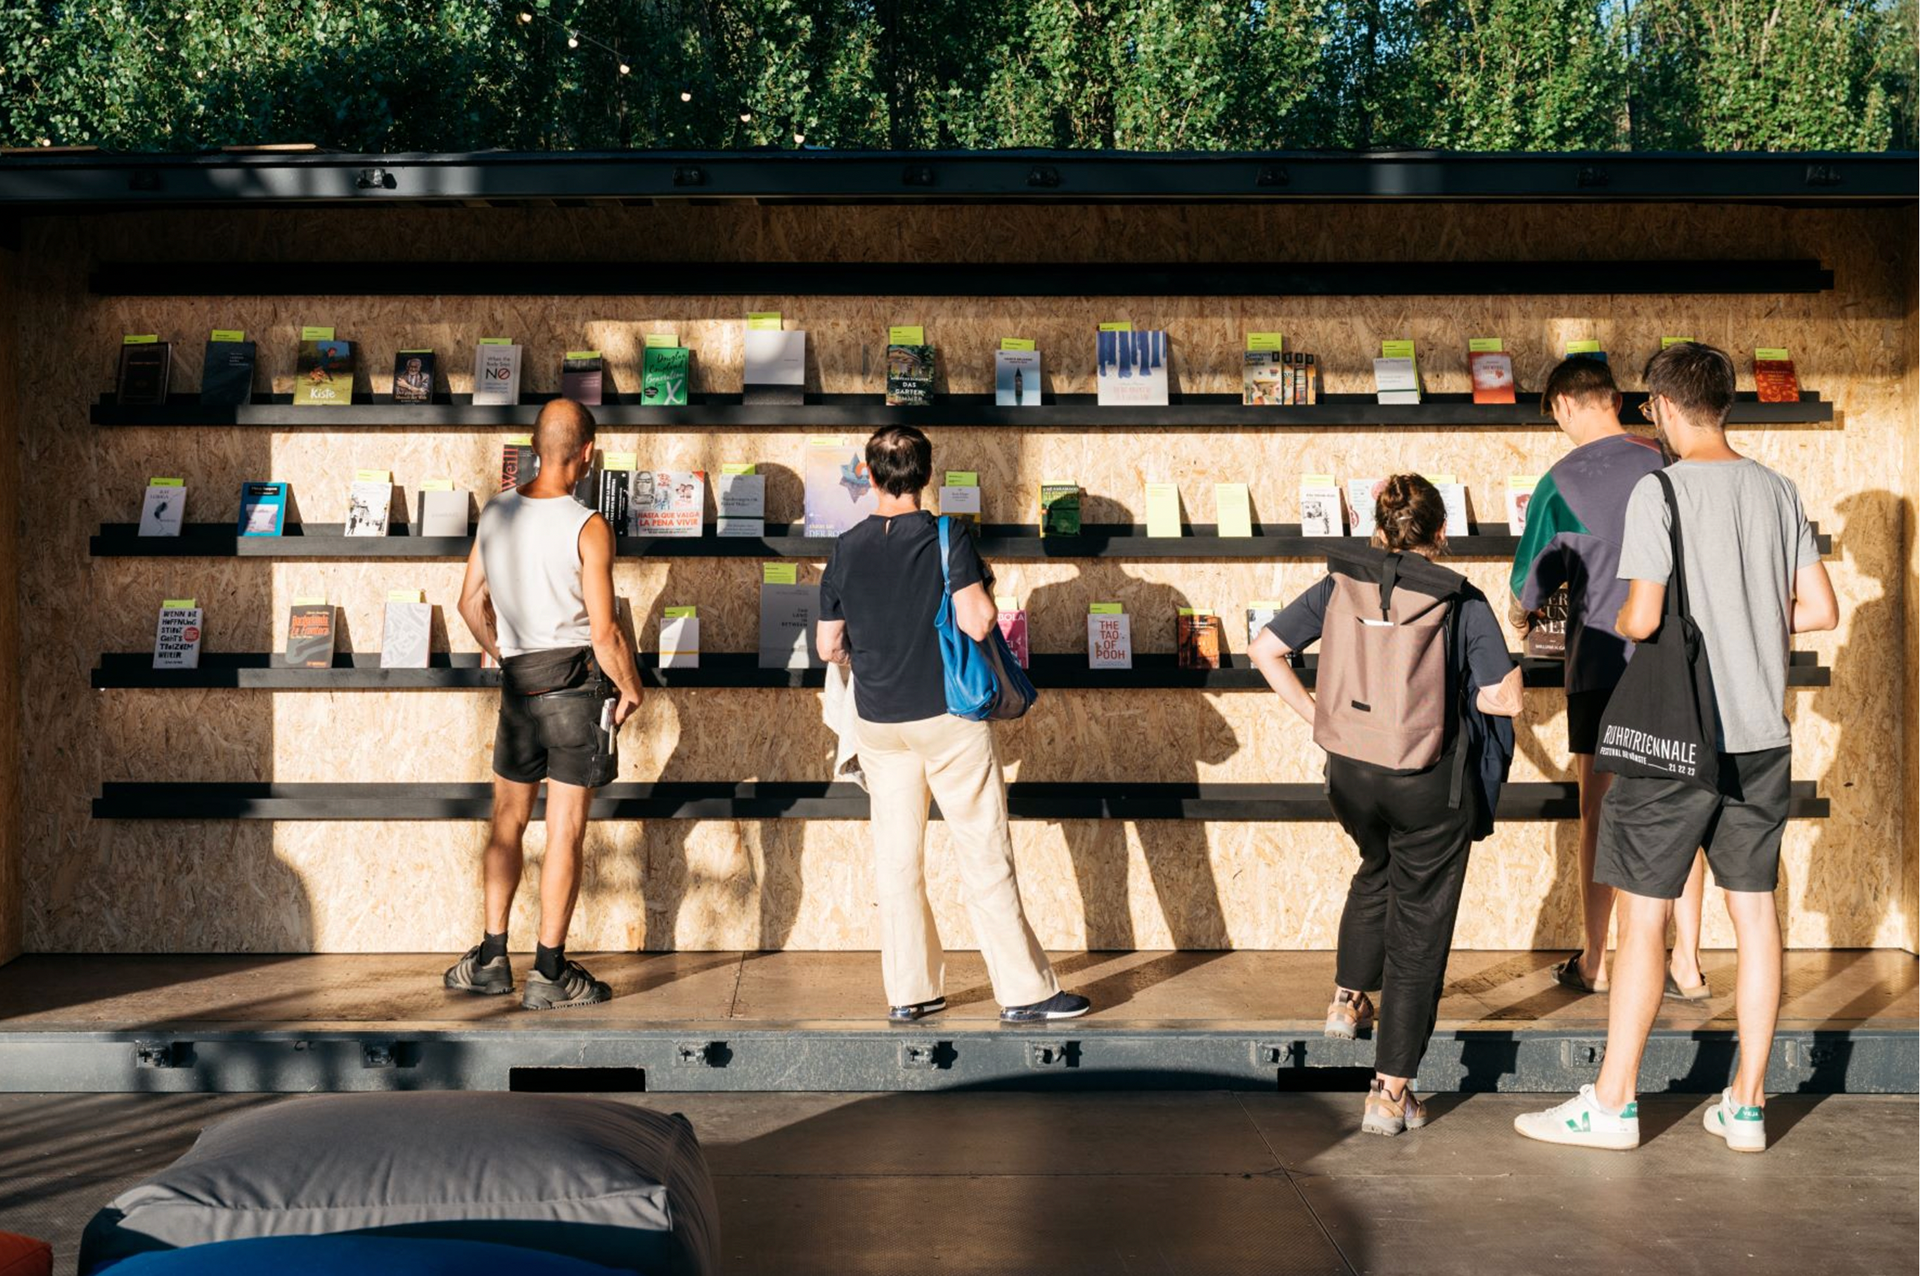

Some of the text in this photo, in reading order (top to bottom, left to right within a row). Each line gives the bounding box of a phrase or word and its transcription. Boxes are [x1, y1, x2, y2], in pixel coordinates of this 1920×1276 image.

[310, 388, 336, 399] Kiste
[663, 380, 682, 405] X
[1100, 621, 1119, 630] THE
[1100, 631, 1119, 640] TAO
[1104, 640, 1117, 649] OF
[1096, 650, 1125, 659] POOH
[1603, 725, 1697, 764] RUHRTRIENNALE
[1600, 746, 1621, 757] FESTIVAL
[1668, 763, 1676, 772] 21
[1678, 765, 1686, 774] 22
[1687, 767, 1695, 776] 23
